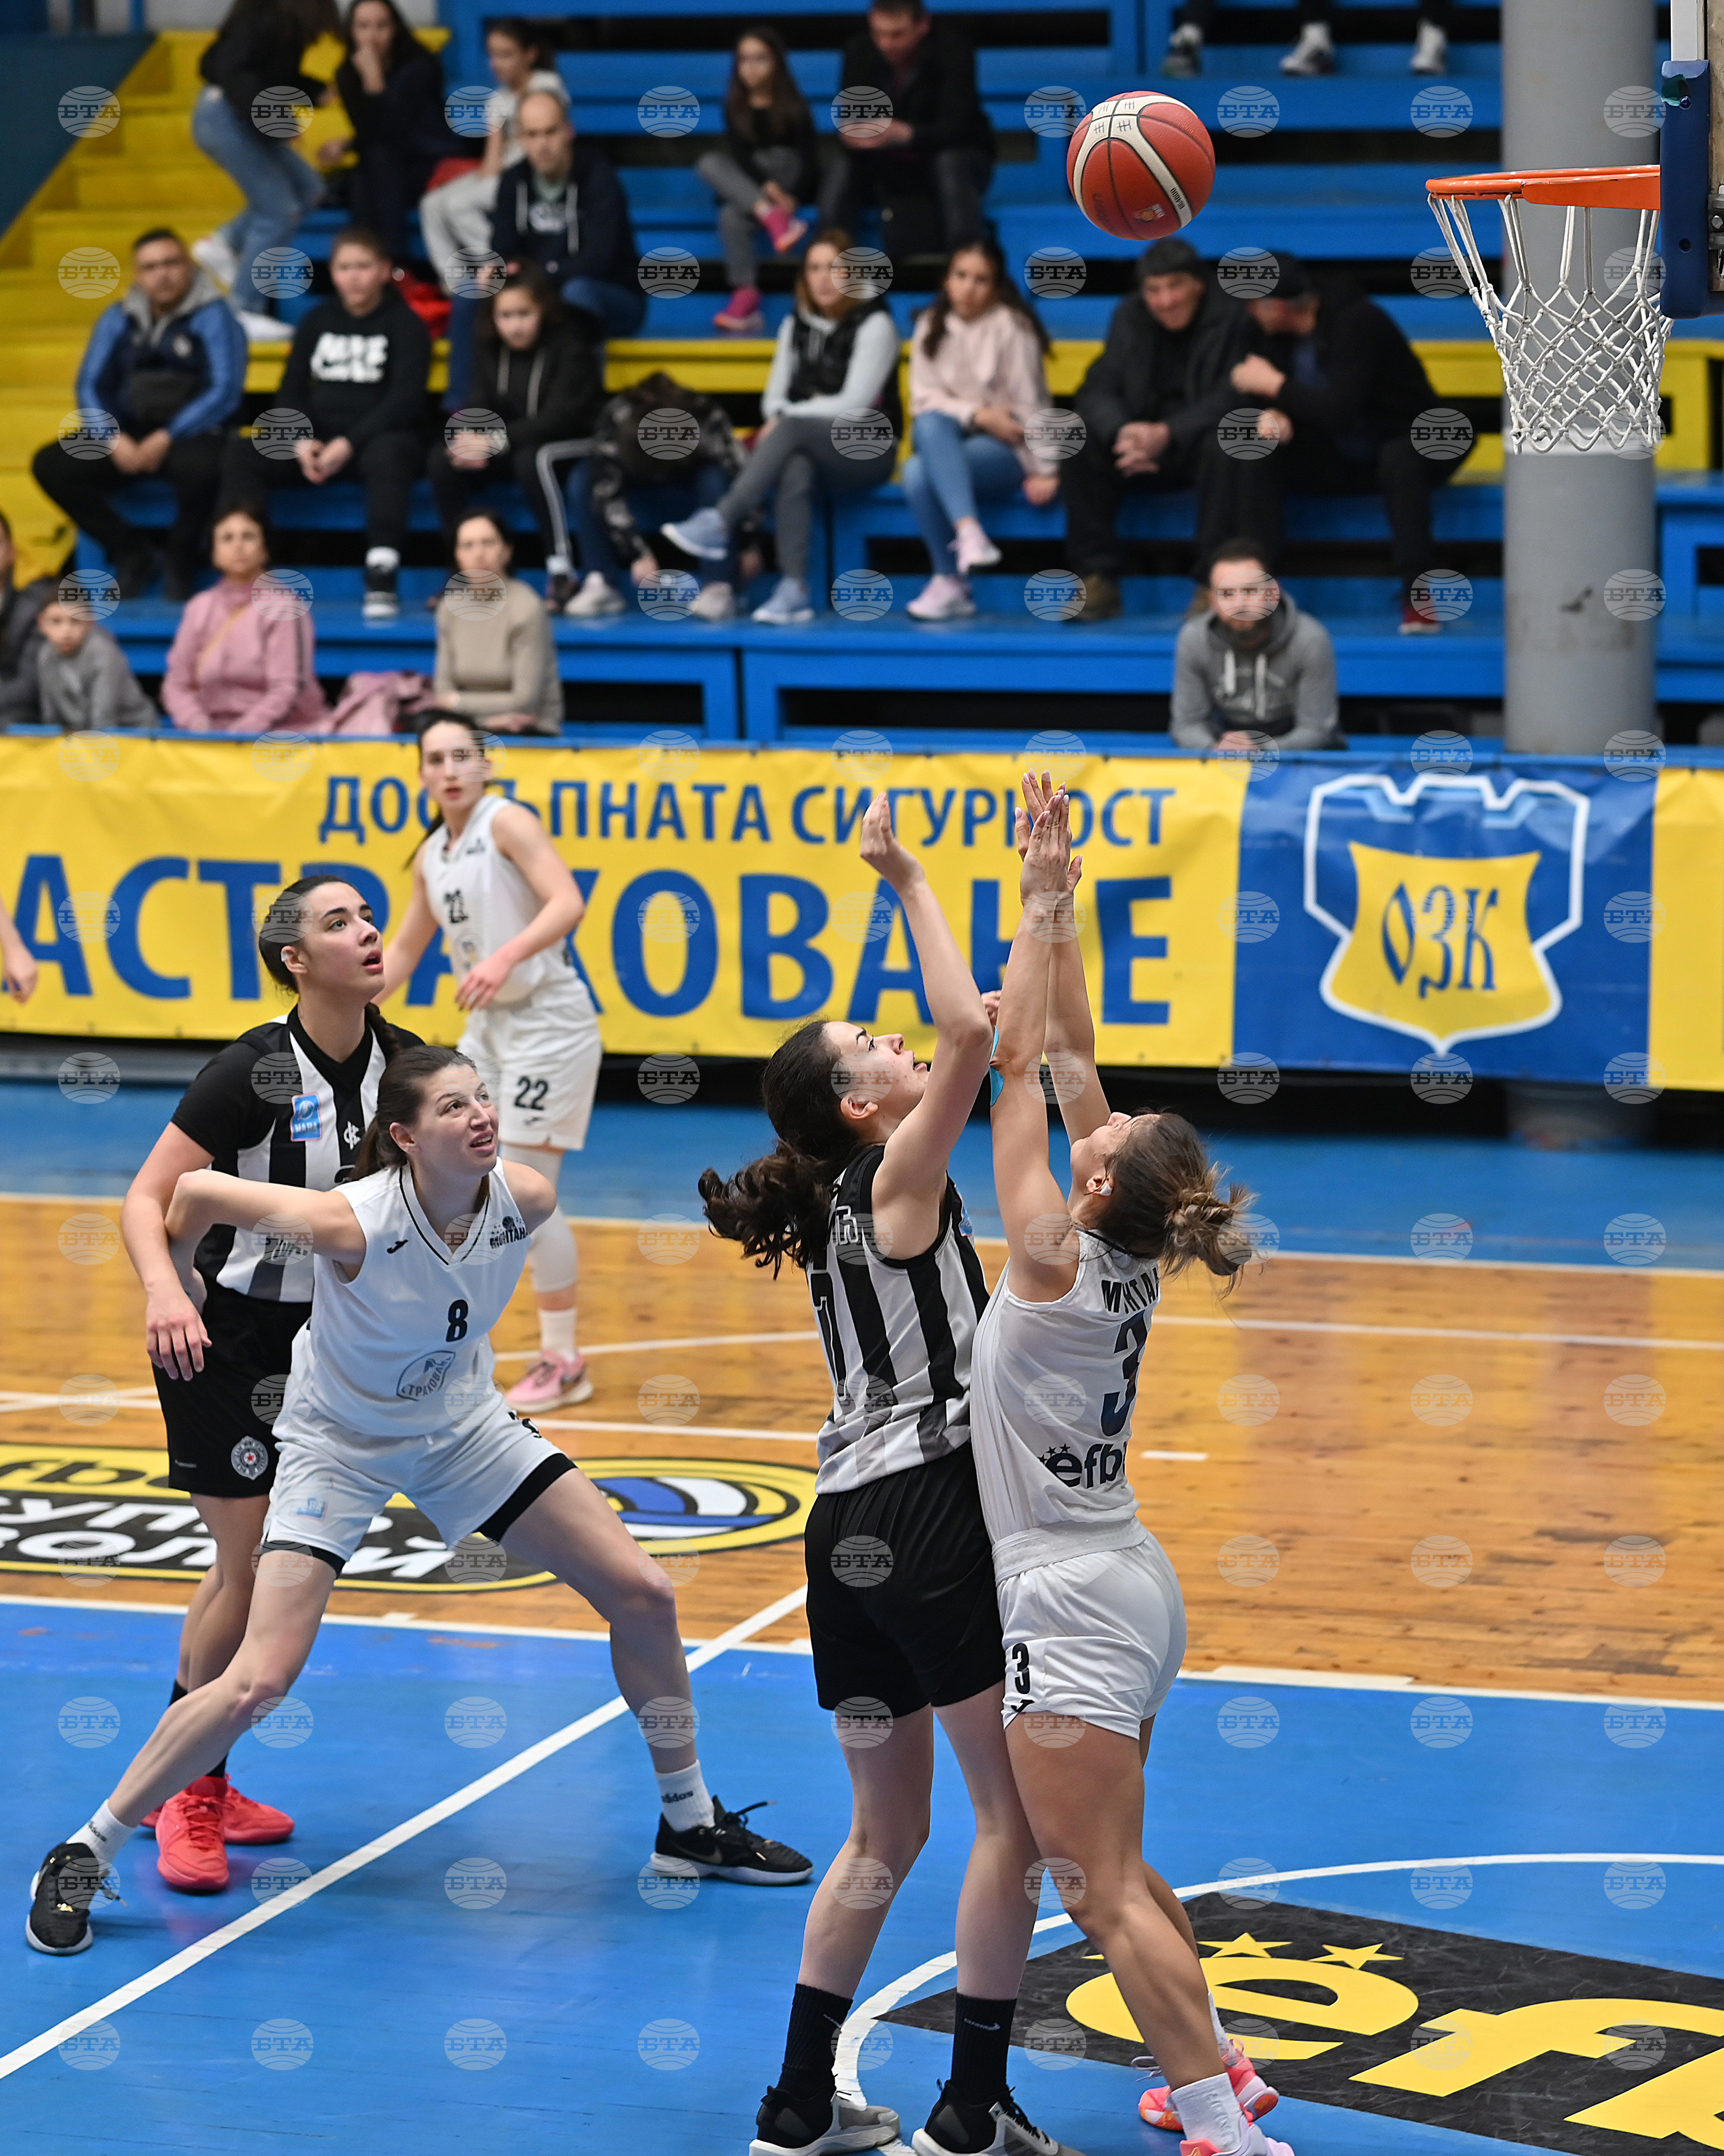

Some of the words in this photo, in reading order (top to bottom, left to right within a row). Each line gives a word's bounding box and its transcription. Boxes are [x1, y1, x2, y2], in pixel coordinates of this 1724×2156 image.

[318, 776, 771, 845] ДОСЪПНАТА
[2, 854, 1172, 1026] АСТРОВАНЕ
[1382, 883, 1499, 999] ОЗК
[514, 1075, 549, 1111] 22
[490, 1227, 528, 1249] МОНТАН
[1101, 1267, 1159, 1314] МНТА
[445, 1299, 469, 1342] 8
[1100, 1309, 1148, 1438] 3
[1044, 1443, 1127, 1488] efb
[1012, 1643, 1031, 1694] 3
